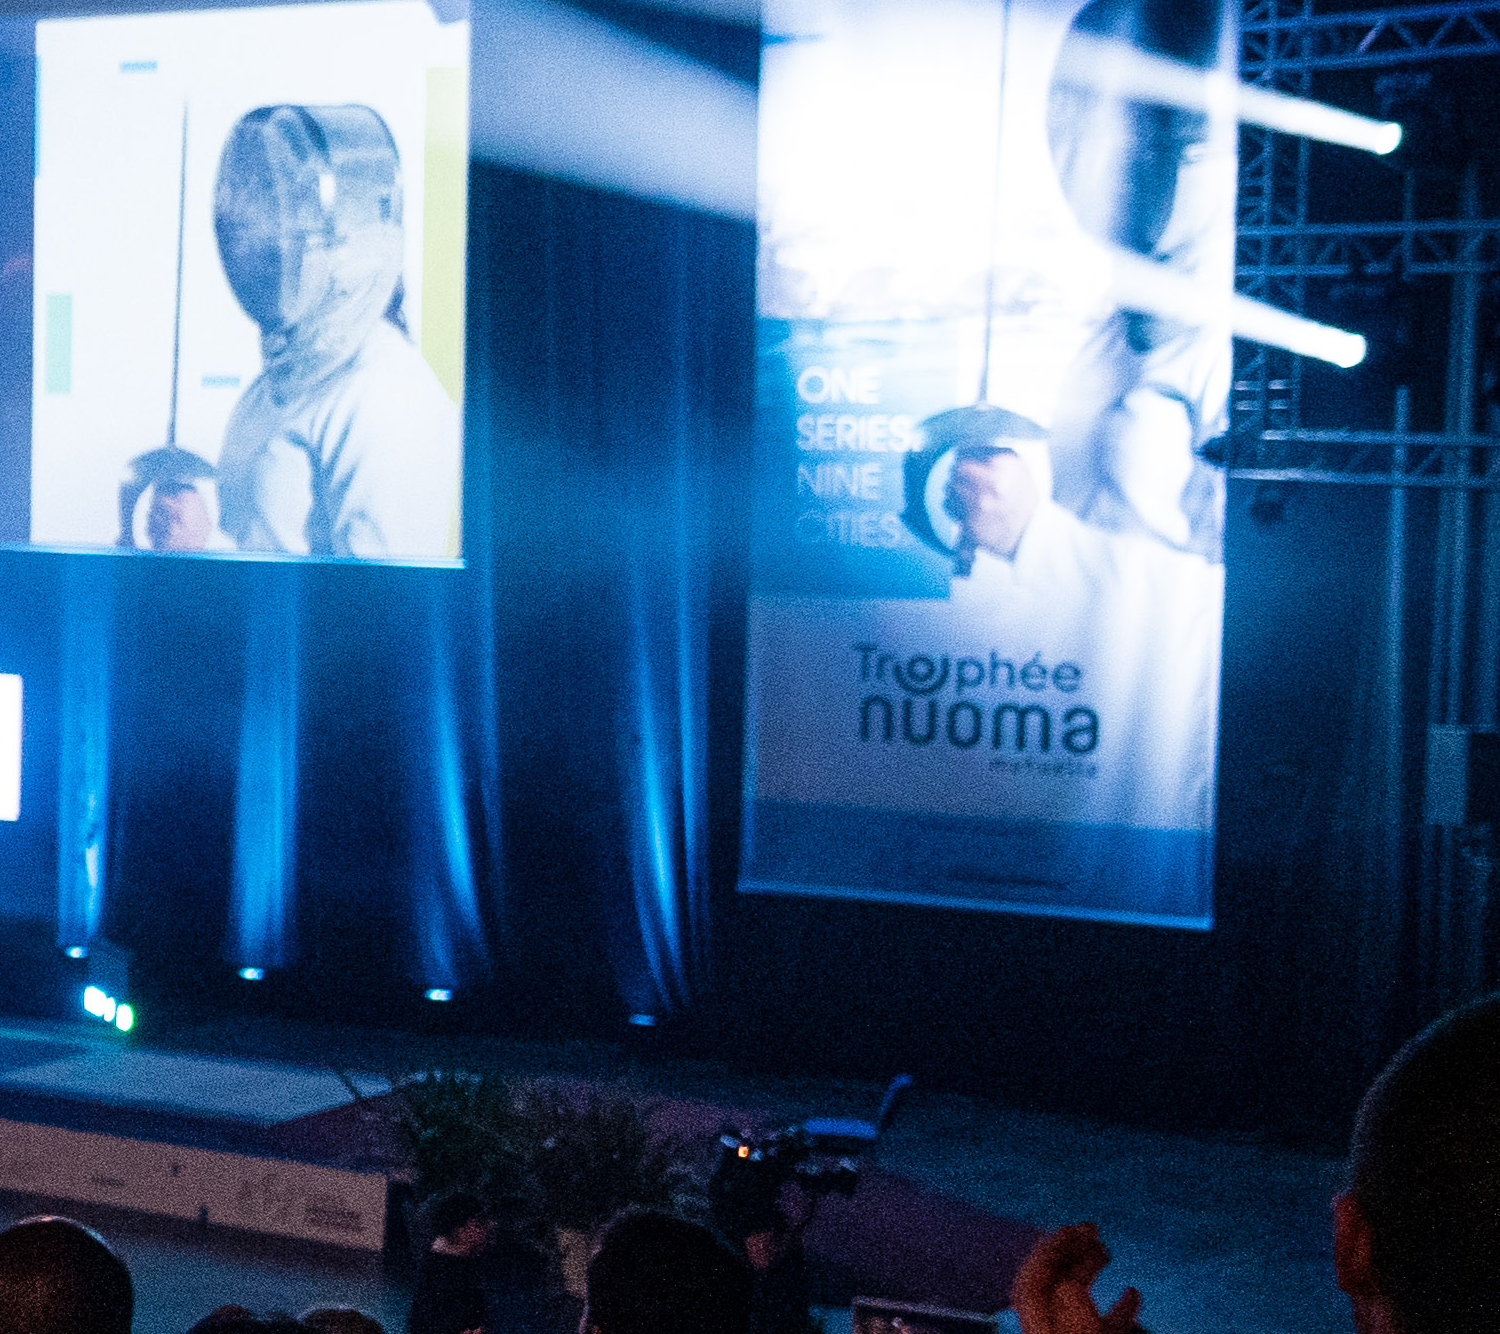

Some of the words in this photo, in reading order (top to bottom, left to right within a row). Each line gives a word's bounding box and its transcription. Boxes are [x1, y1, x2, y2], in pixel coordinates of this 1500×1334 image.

[796, 366, 880, 405] ONE
[796, 462, 882, 500] NINE
[853, 642, 1082, 696] Trophée
[859, 693, 1101, 755] nuoma
